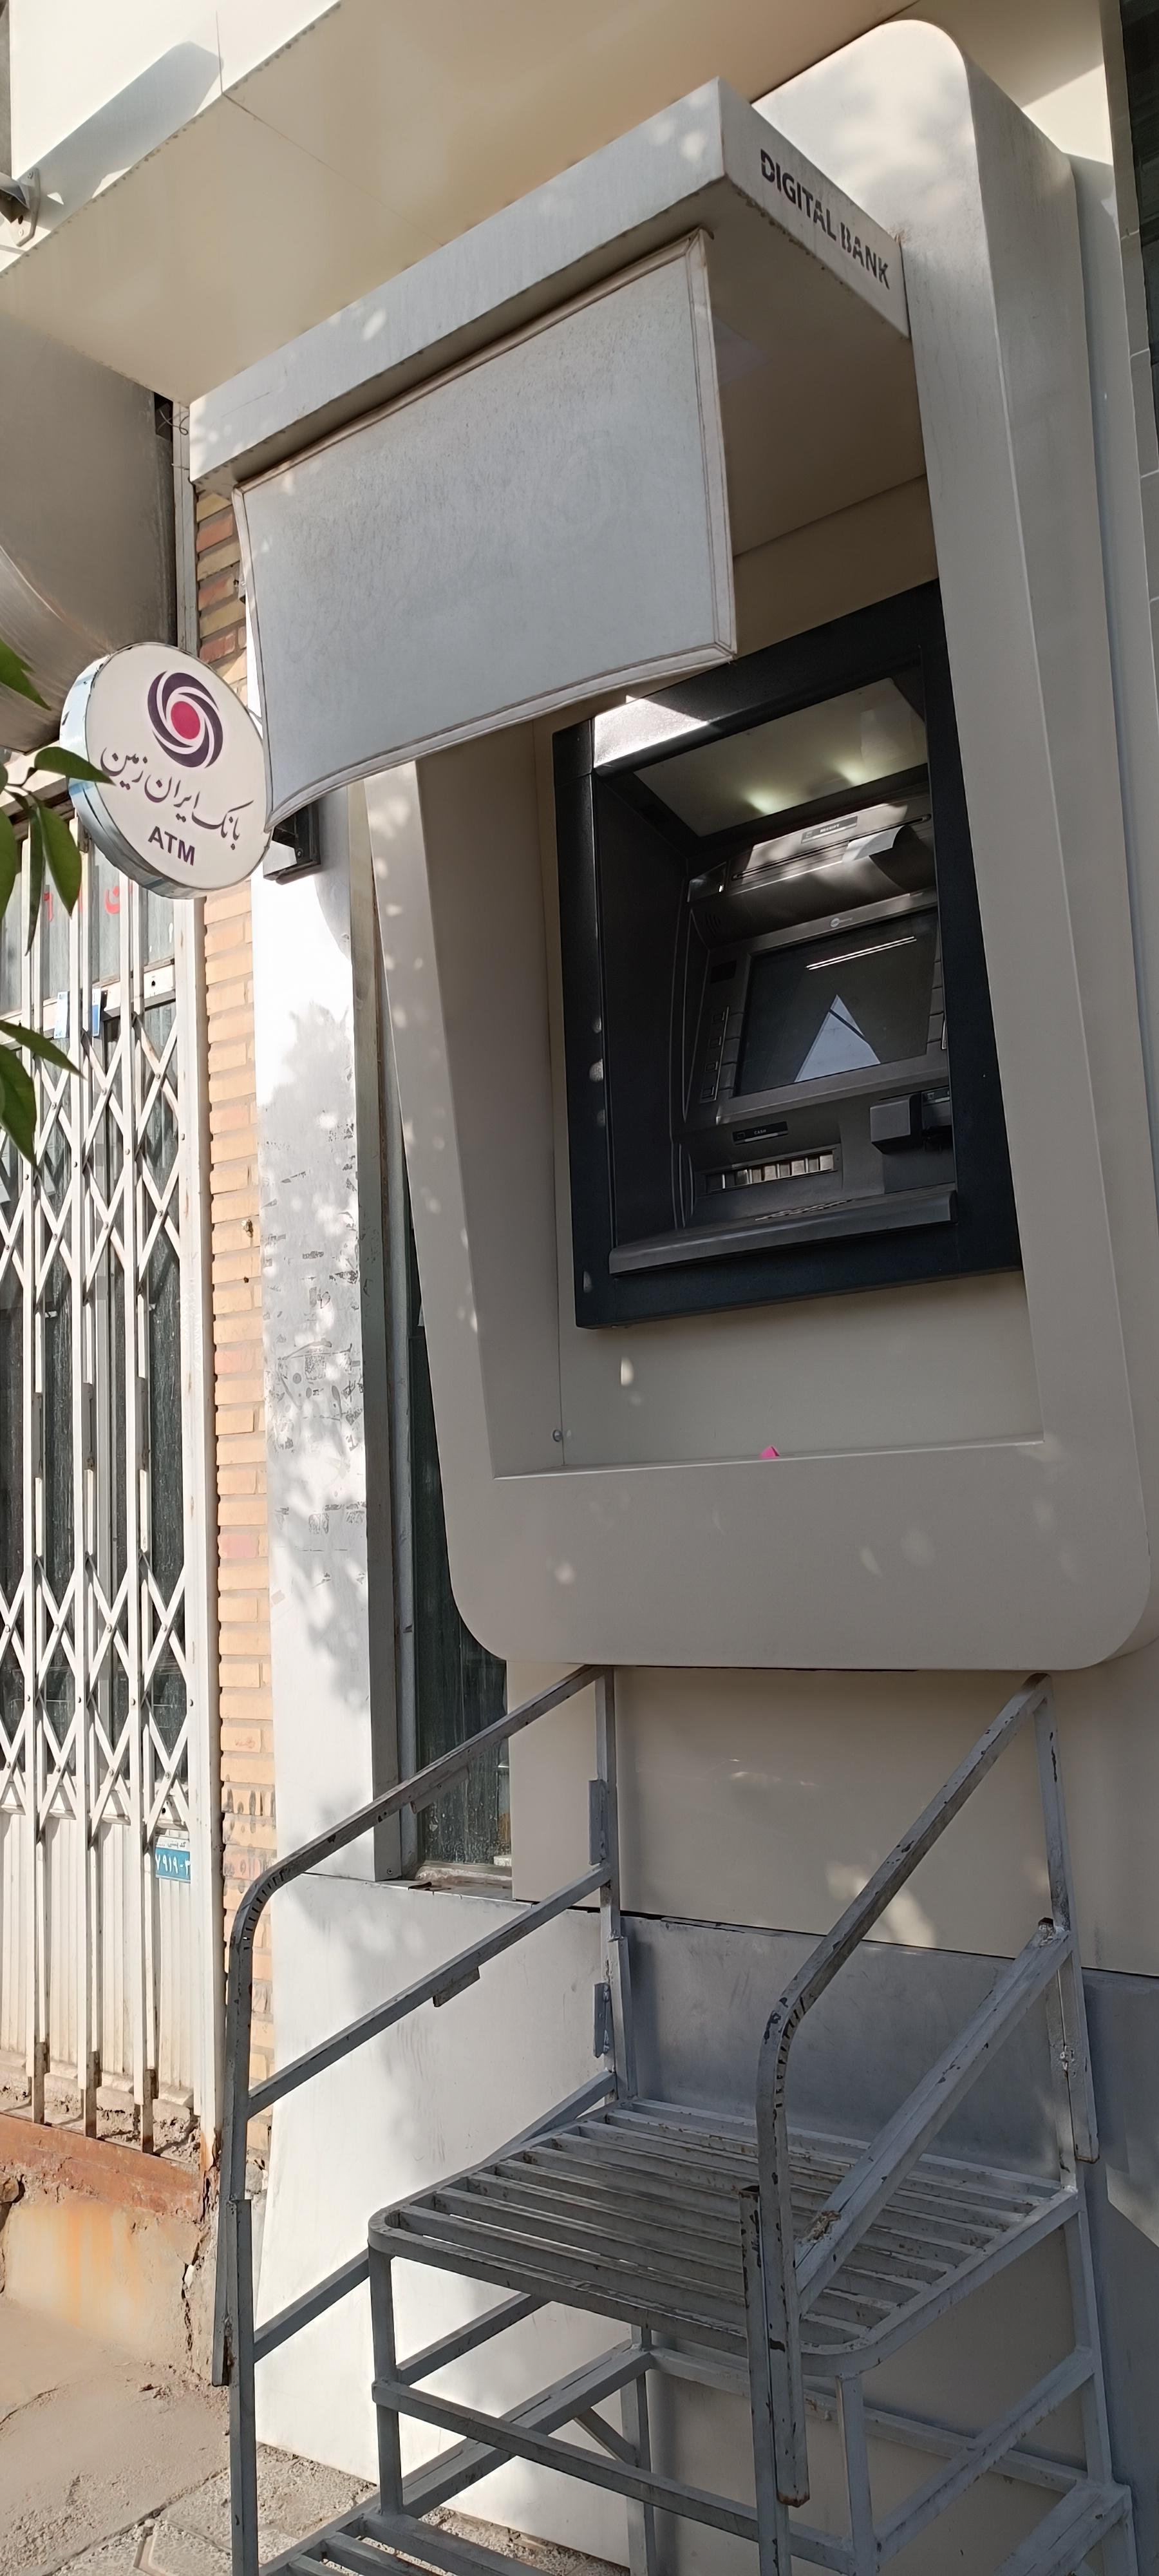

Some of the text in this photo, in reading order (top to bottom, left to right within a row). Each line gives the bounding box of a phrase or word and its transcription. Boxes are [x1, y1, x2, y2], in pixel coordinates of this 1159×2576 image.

[760, 148, 890, 290] DIGITAL BANK
[100, 747, 254, 850] بانک ایران زمین
[148, 826, 195, 866] ATM
